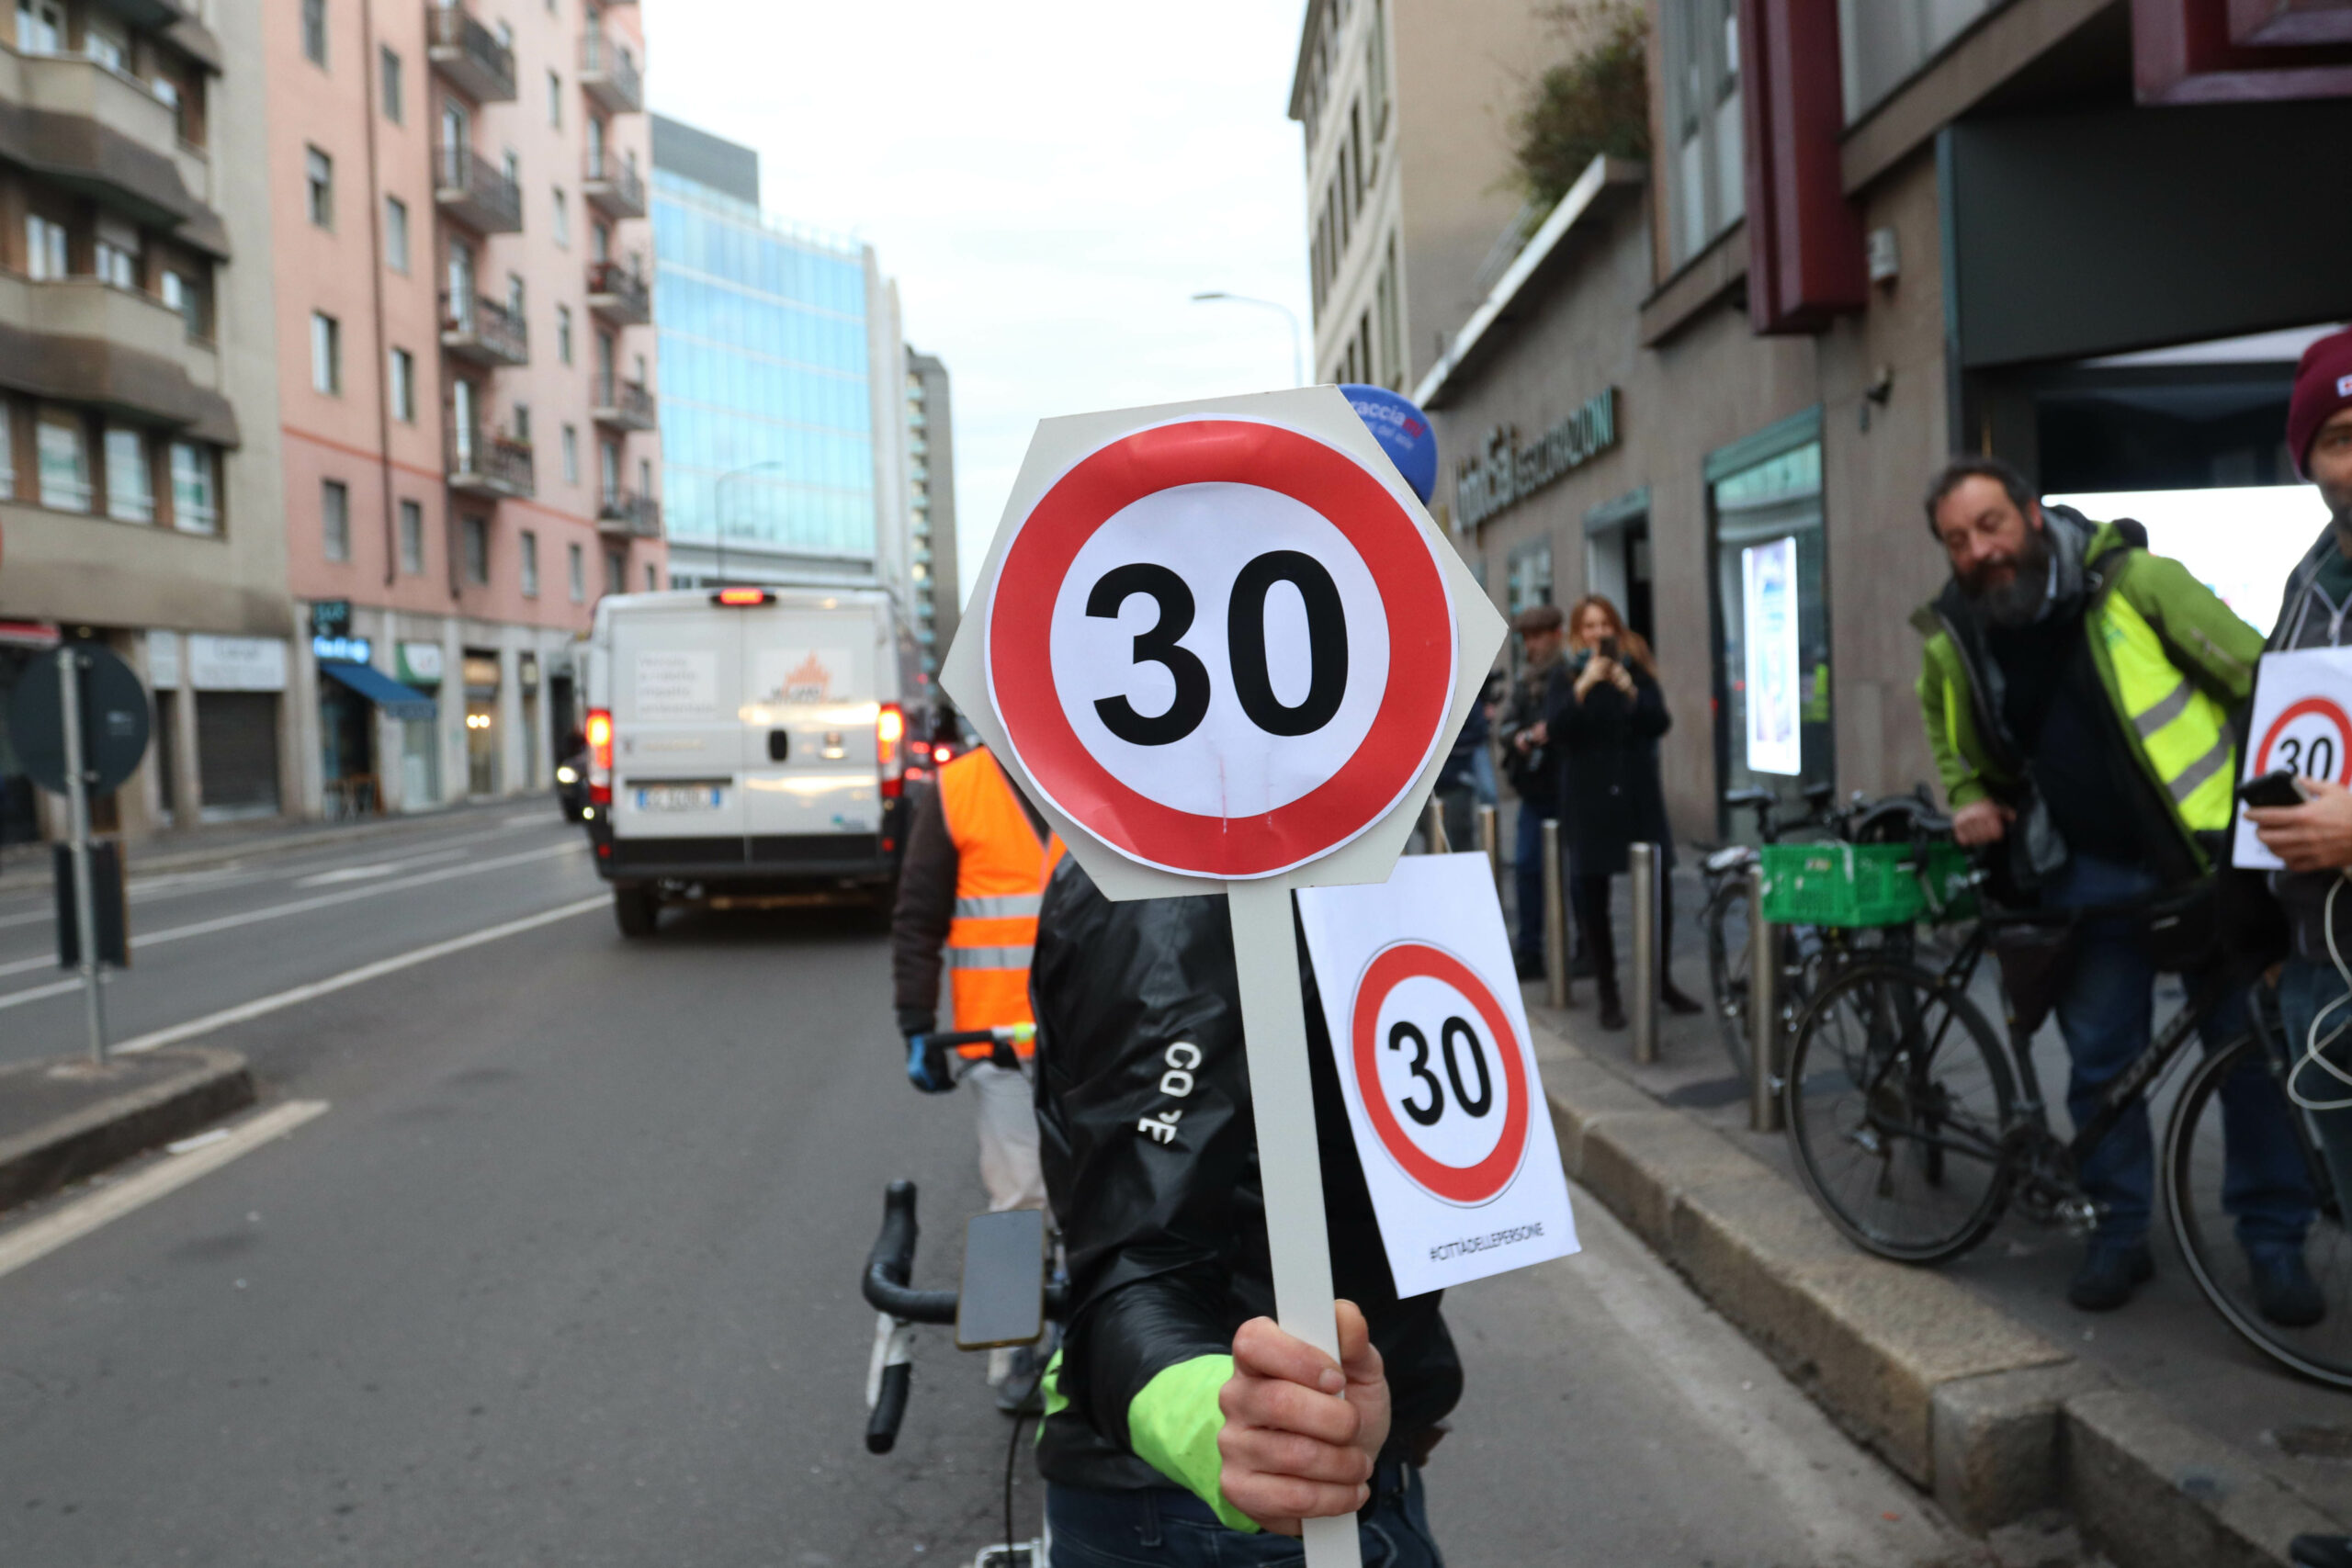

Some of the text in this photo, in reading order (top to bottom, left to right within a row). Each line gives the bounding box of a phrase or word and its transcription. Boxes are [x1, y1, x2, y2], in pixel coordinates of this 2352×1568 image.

[1350, 400, 1429, 439] racciami
[1085, 549, 1349, 746] 30
[2279, 737, 2334, 781] 30
[1388, 1015, 1493, 1126] 30
[1430, 1223, 1545, 1262] #CITTÀDELLEPERSONE
